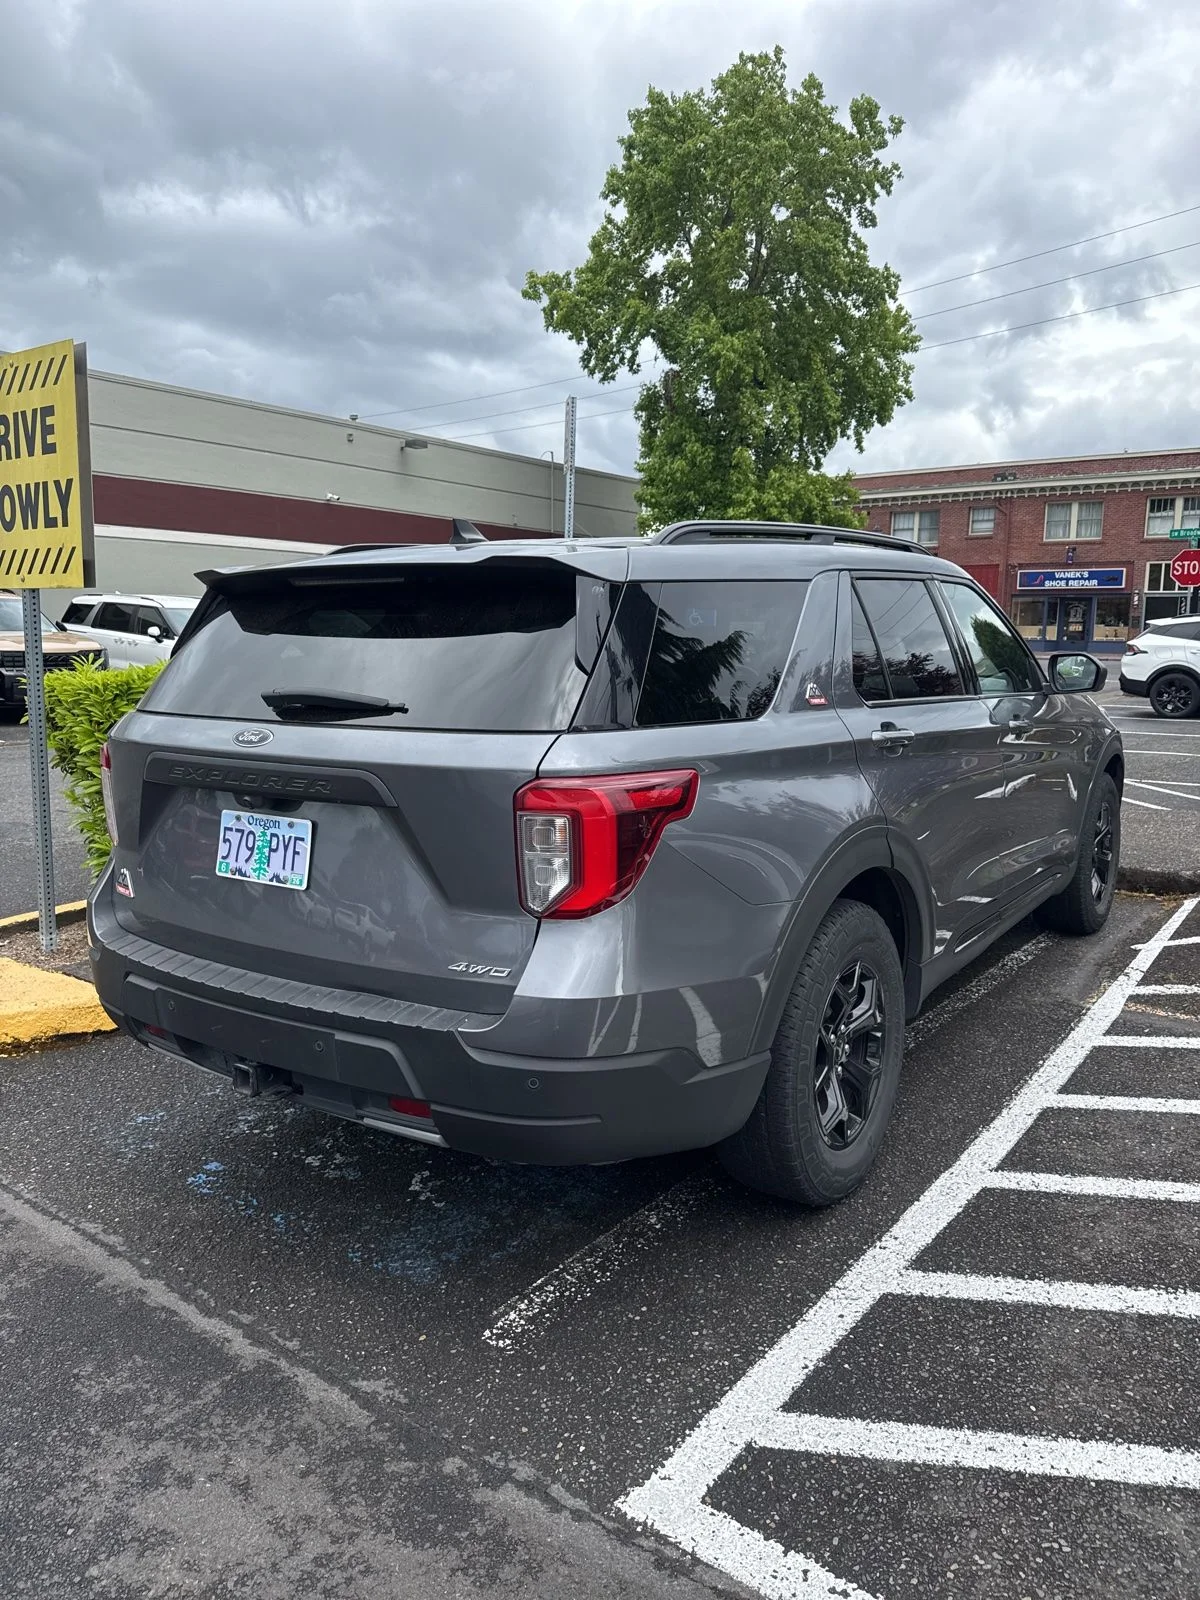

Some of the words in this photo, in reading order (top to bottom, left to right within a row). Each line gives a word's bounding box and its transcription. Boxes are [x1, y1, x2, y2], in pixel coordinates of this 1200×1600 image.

[1173, 561, 1200, 575] STO
[1069, 579, 1098, 587] REPAIR
[168, 766, 333, 794] EXPLORER
[247, 815, 281, 830] Oregon
[221, 826, 256, 864] 579
[267, 832, 305, 871] PYF
[221, 862, 227, 872] 6
[448, 962, 511, 977] 4WD
